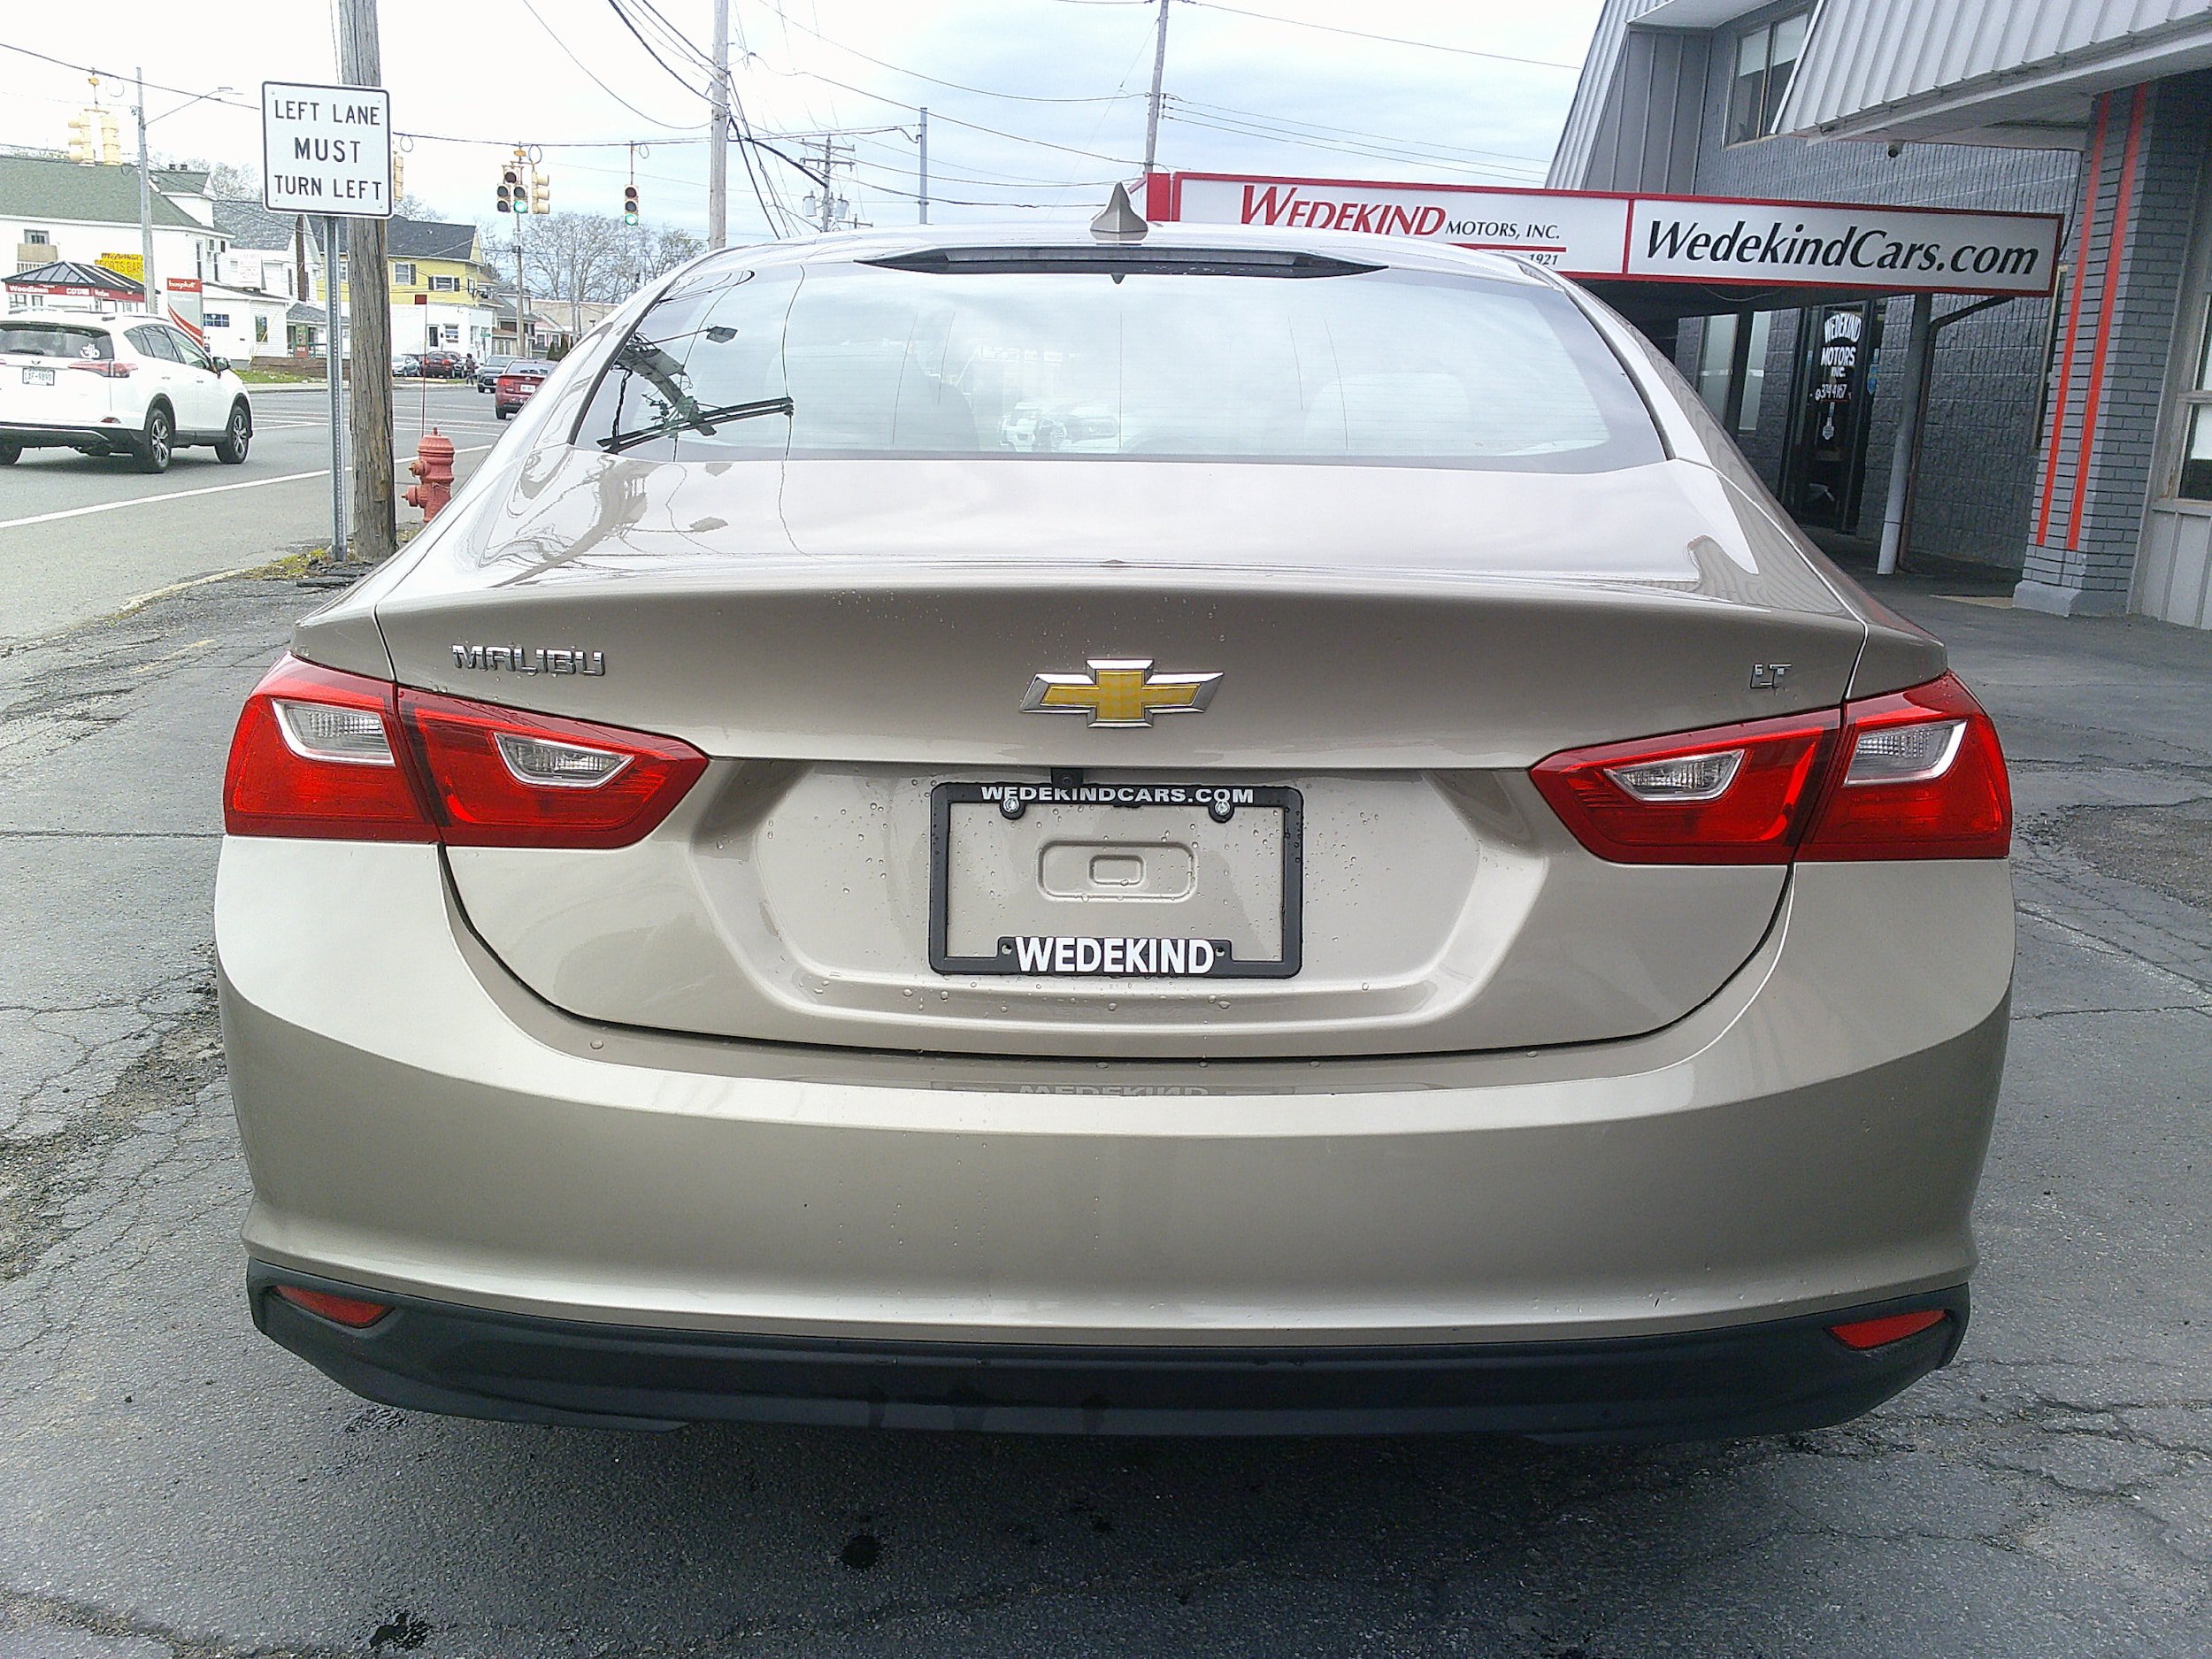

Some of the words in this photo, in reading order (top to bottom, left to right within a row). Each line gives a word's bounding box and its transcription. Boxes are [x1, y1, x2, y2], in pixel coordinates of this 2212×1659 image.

[274, 99, 319, 121] LEFT
[333, 104, 380, 126] LANE
[295, 136, 361, 164] MUST
[274, 174, 322, 196] TURN
[333, 178, 382, 200] LEFT
[1240, 185, 1447, 236] WEDEKIND
[1445, 220, 1521, 241] MOTORS,
[1525, 224, 1560, 240] INC.
[1647, 219, 2039, 276] WedekindCars.com
[1824, 313, 1862, 343] WEDEKIND
[1820, 346, 1857, 367] MOTORS
[452, 644, 605, 677] MALIBU
[1750, 663, 1792, 689] LT
[980, 786, 1255, 803] WEDEKINDCARS.COM
[1015, 937, 1216, 974] WEDEKIND
